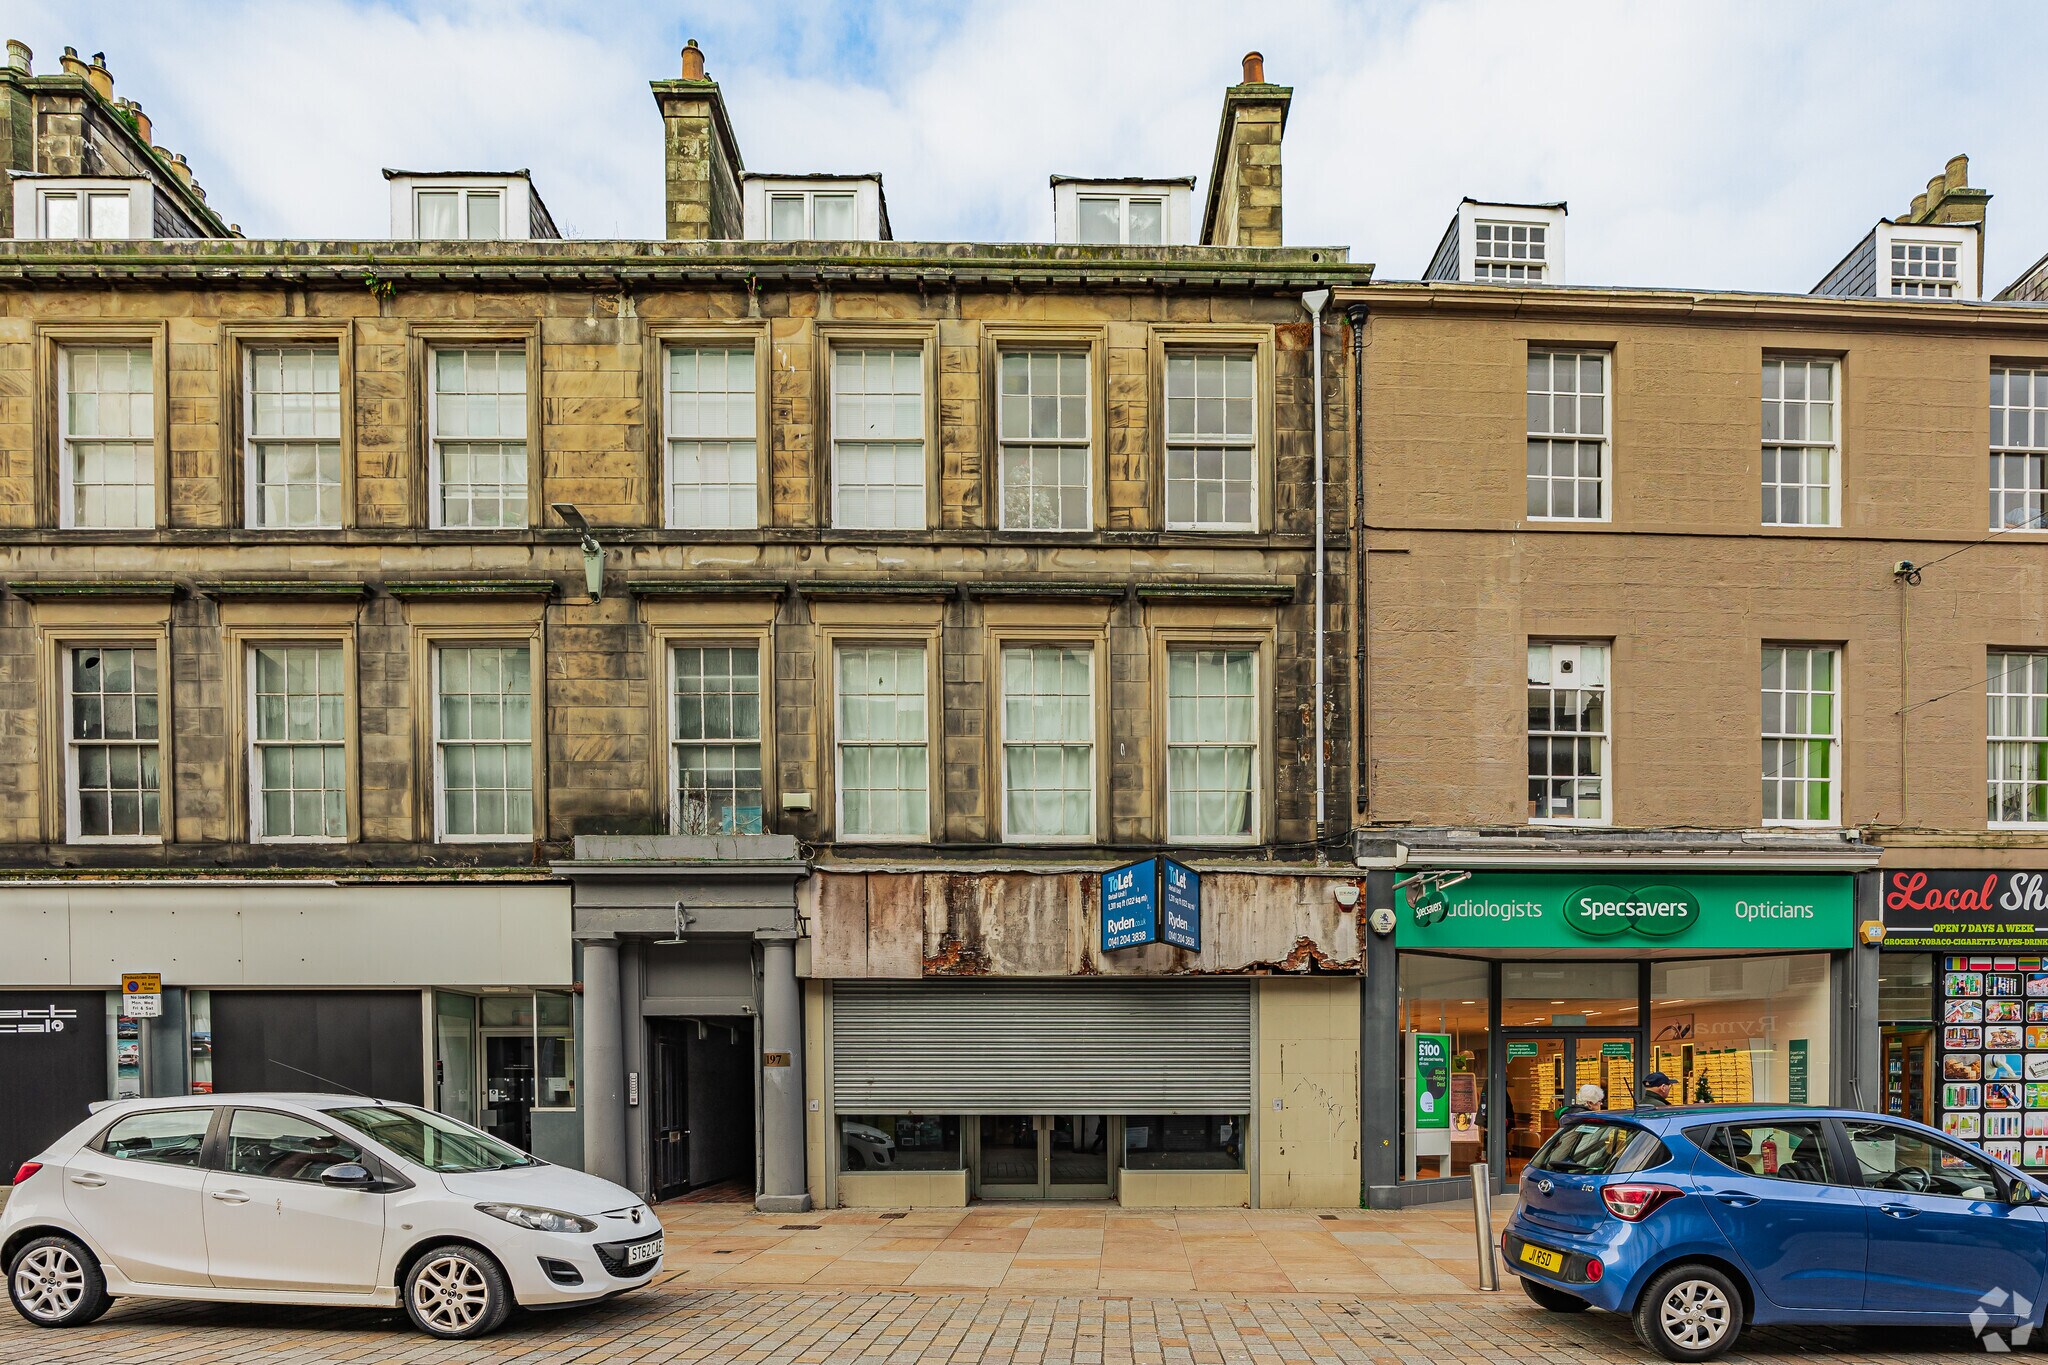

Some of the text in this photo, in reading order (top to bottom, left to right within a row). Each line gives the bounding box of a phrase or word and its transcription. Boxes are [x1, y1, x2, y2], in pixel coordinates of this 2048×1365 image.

[1886, 872, 2048, 911] Local Sh
[1126, 897, 1134, 906] (122
[1415, 900, 1442, 919] Specsavers
[1447, 898, 1814, 922] udiologists Specsavers Opticians
[1933, 924, 2035, 933] OPEN 7 DAYS A WEEK
[1108, 931, 1146, 947] 0141 204 3838
[1418, 1044, 1440, 1056] £100
[766, 1055, 782, 1065] 197
[632, 1244, 651, 1261] ST62
[1536, 1250, 1552, 1267] RSD
